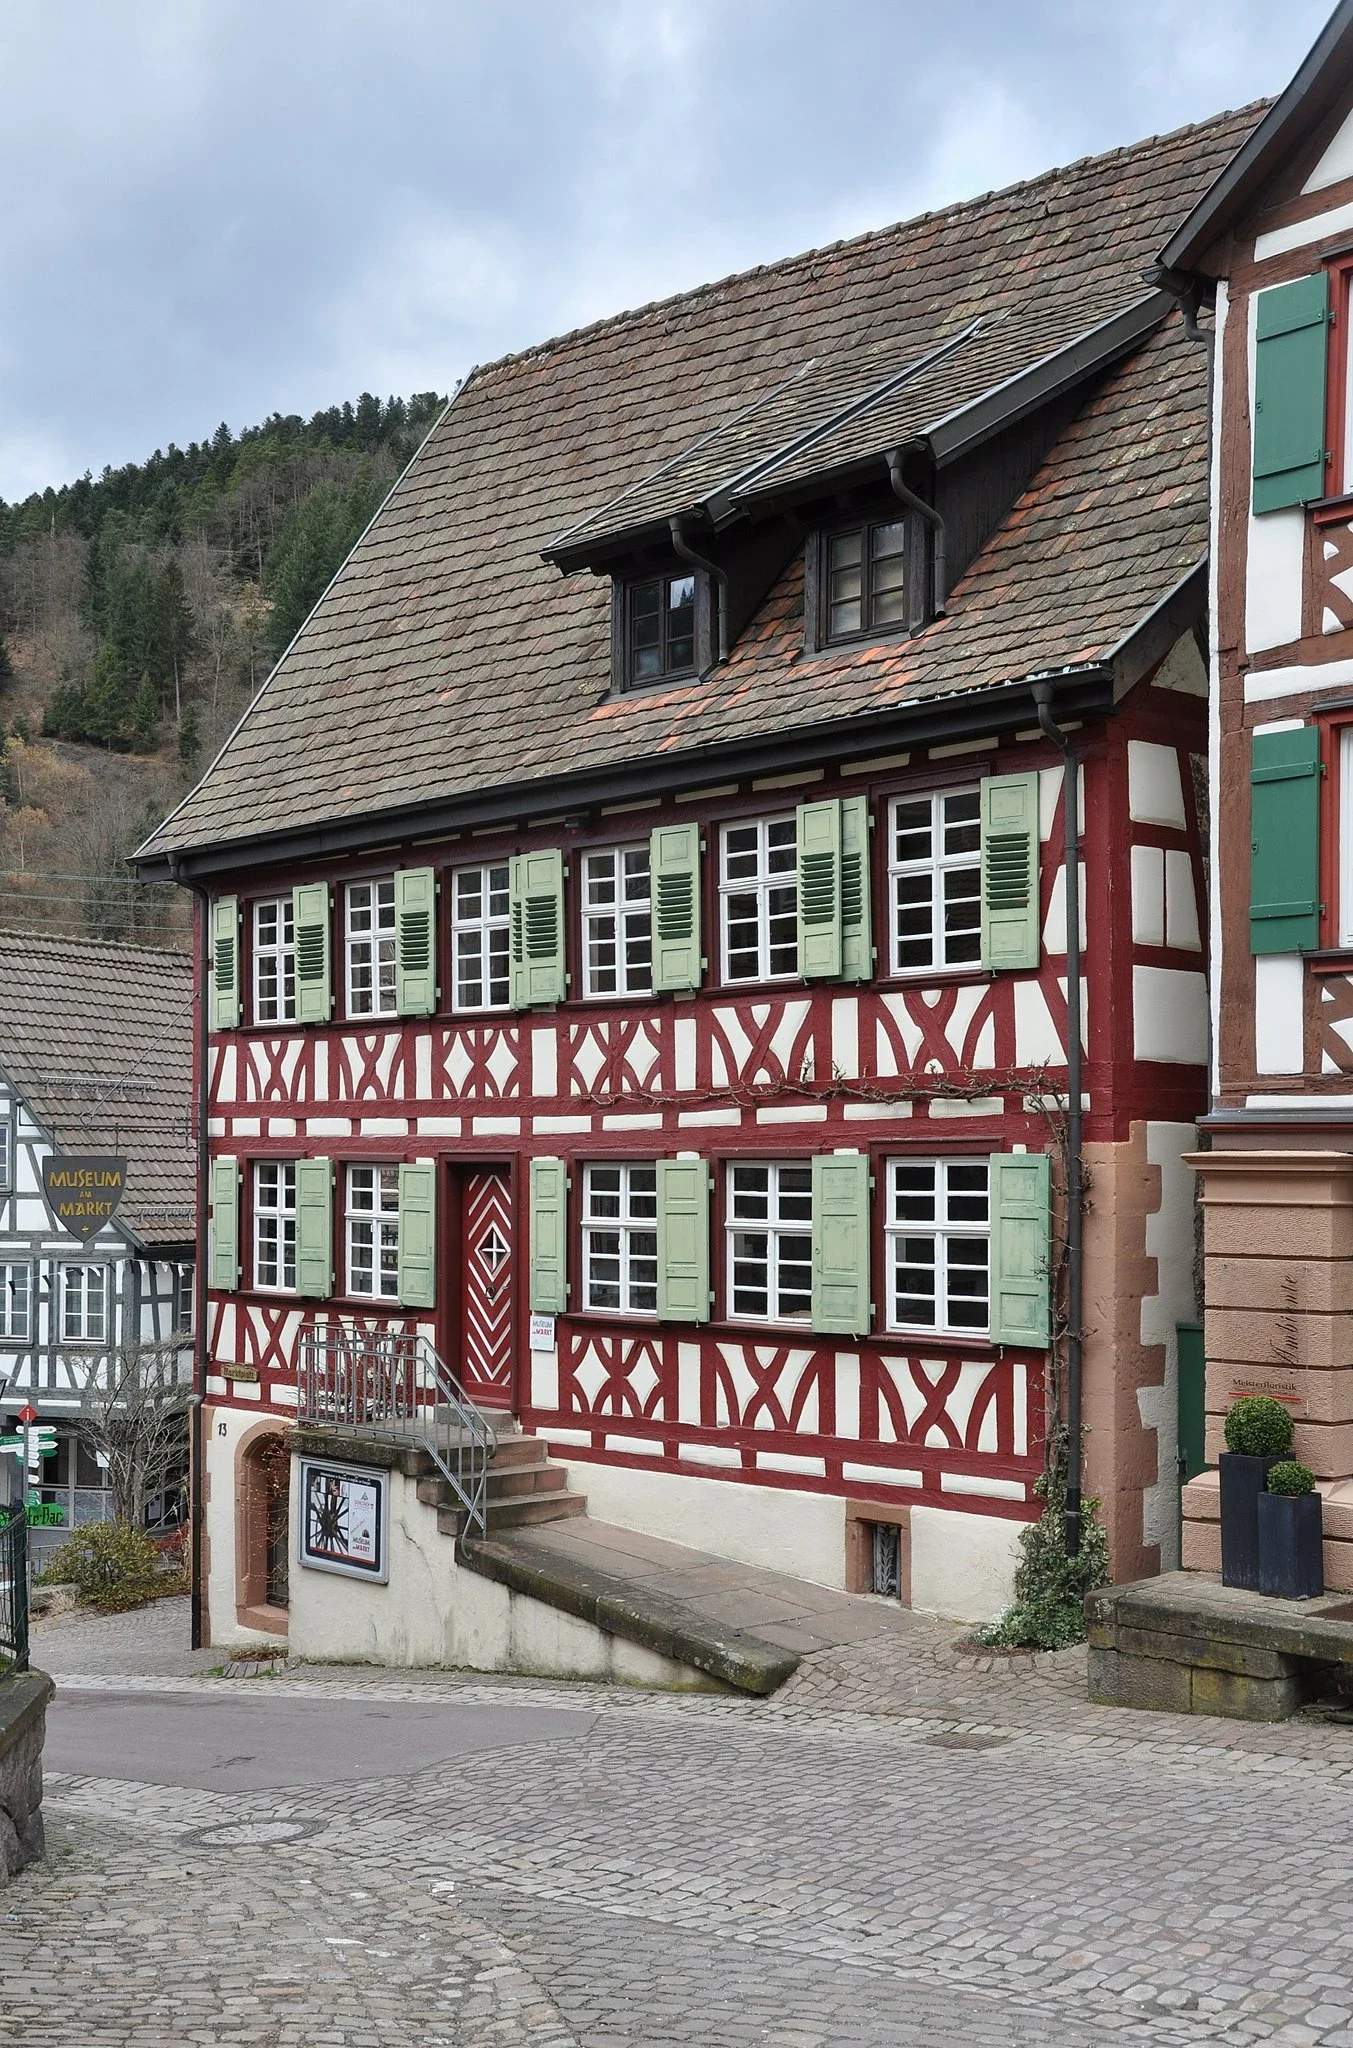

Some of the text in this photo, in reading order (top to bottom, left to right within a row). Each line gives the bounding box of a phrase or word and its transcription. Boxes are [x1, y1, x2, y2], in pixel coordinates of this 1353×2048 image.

[50, 1169, 121, 1187] MUSEUM
[59, 1202, 112, 1216] MARKT
[532, 1320, 552, 1328] MUSEUM
[536, 1328, 552, 1336] MARKT
[1233, 1379, 1297, 1391] Meisterfloristik
[217, 1422, 227, 1437] 13
